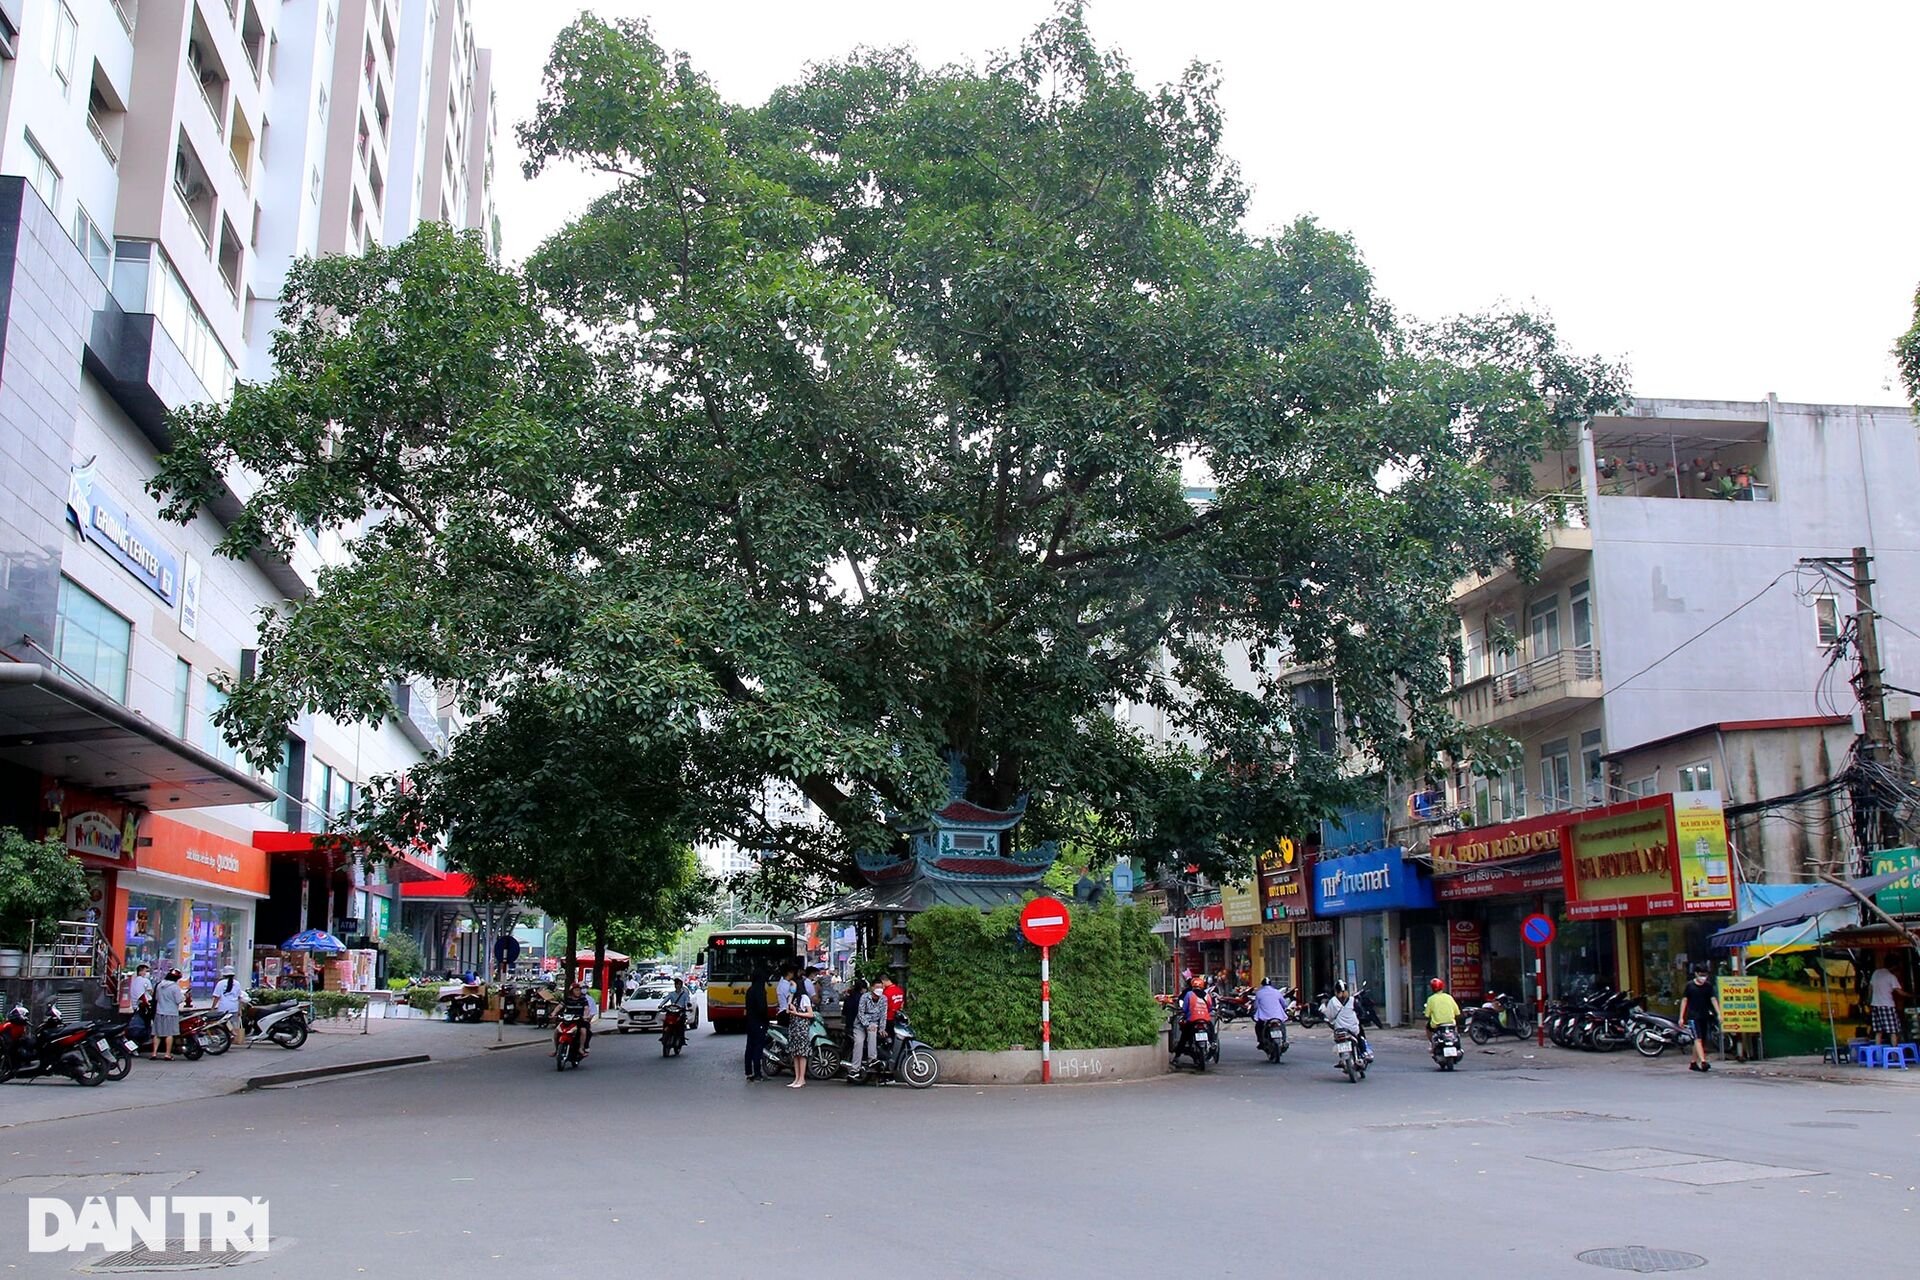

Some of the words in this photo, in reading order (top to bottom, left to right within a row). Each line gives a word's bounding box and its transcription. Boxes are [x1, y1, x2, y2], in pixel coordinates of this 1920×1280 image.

[95, 507, 129, 551] GAMING
[129, 536, 159, 578] CENTER
[1432, 843, 1457, 874] 66
[1457, 839, 1489, 862] BÚN
[1491, 831, 1531, 858] RIÊU
[1321, 876, 1337, 897] TH
[340, 921, 356, 929] ATM
